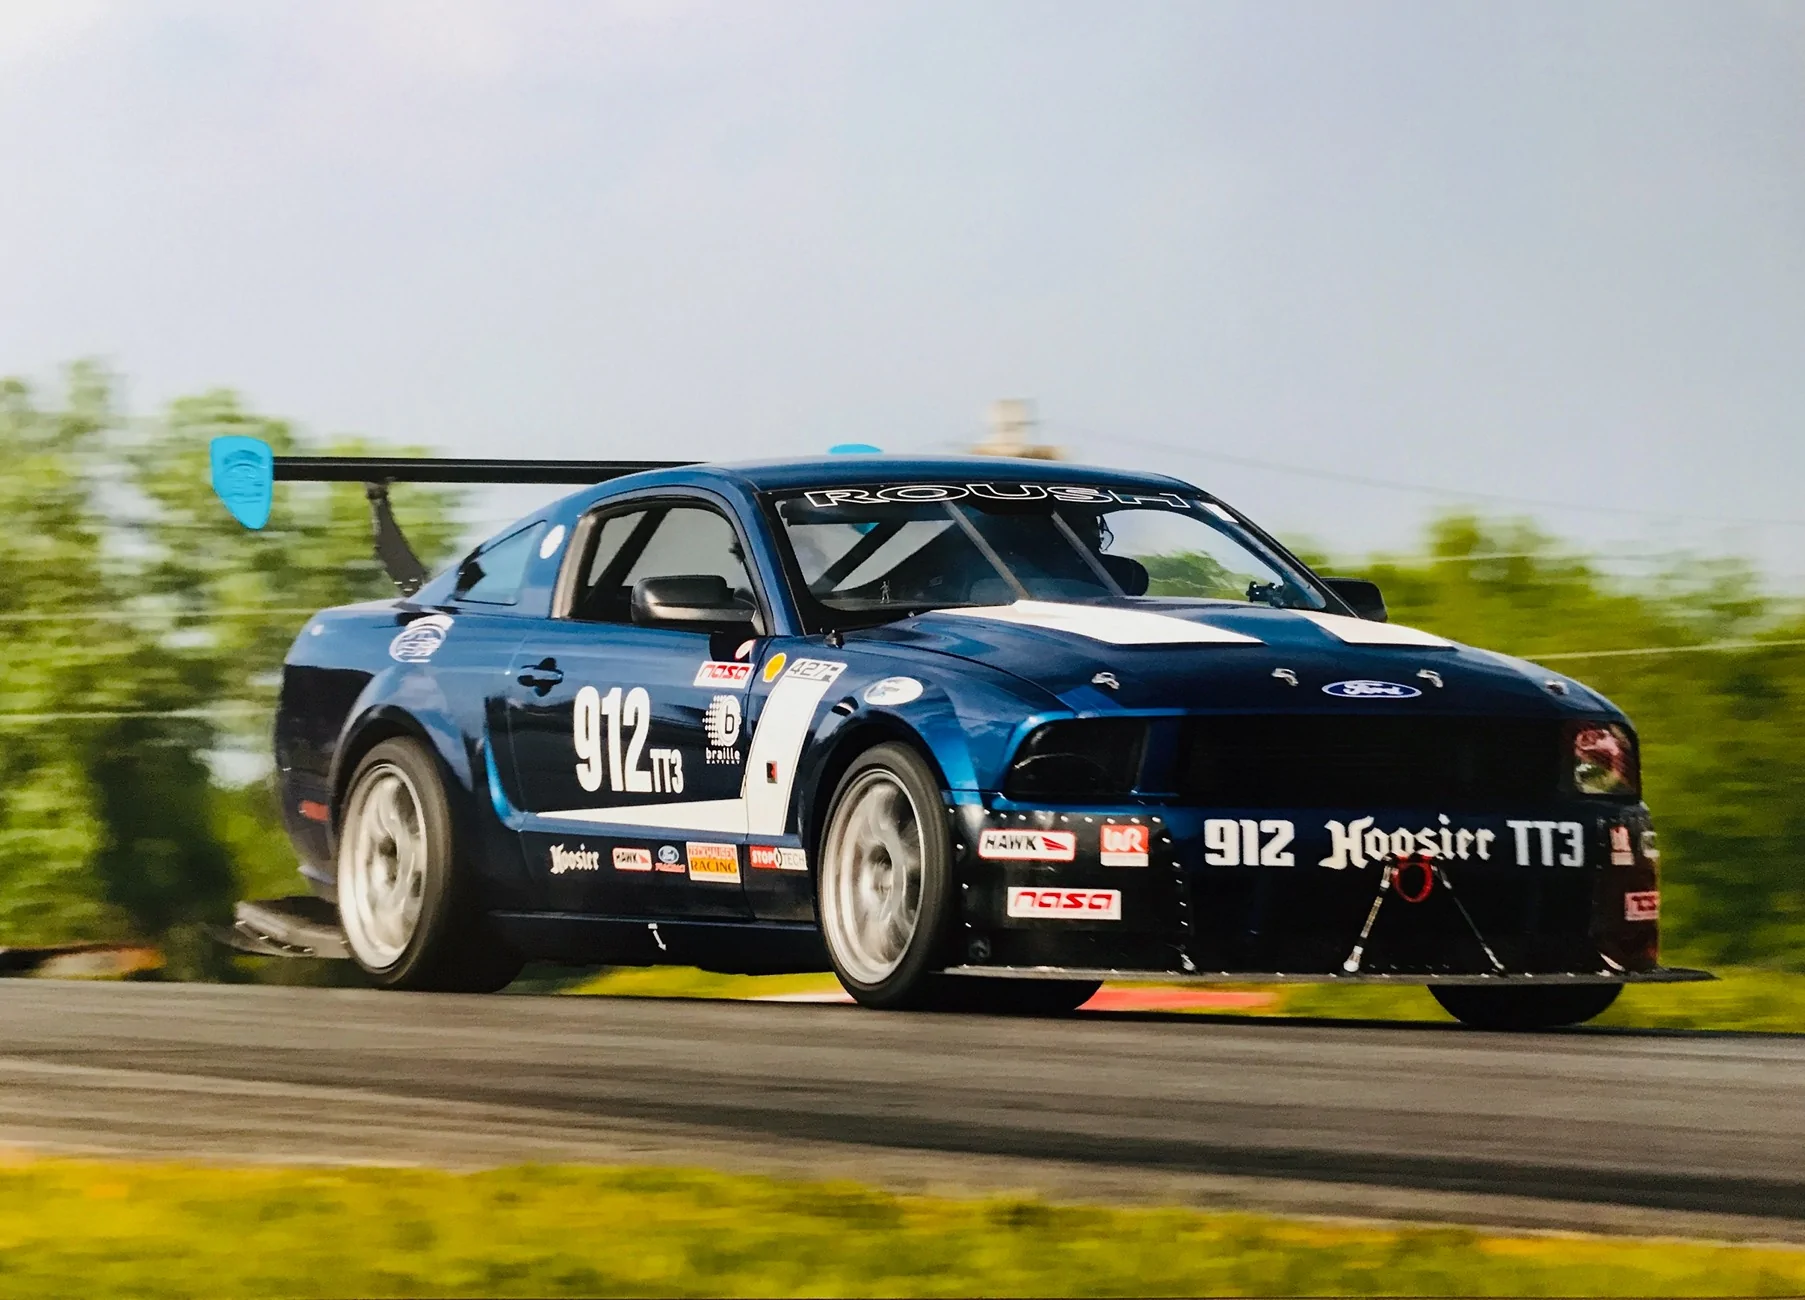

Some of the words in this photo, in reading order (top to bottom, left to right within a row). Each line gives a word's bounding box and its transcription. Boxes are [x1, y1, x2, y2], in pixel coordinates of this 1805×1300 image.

[803, 483, 1191, 508] ROUSH
[698, 664, 751, 681] nasa
[1342, 681, 1404, 695] Ford
[574, 685, 652, 793] 912
[650, 748, 684, 794] TT3
[705, 746, 741, 760] braille
[985, 834, 1038, 851] HAWK
[1203, 818, 1296, 867] 912
[1318, 812, 1496, 870] Hoosier
[1506, 819, 1584, 868] TT3
[550, 842, 600, 875] Hoosier
[751, 849, 774, 865] STOP
[782, 852, 805, 865] TECH
[690, 860, 738, 873] RACING
[1014, 891, 1113, 910] nasa
